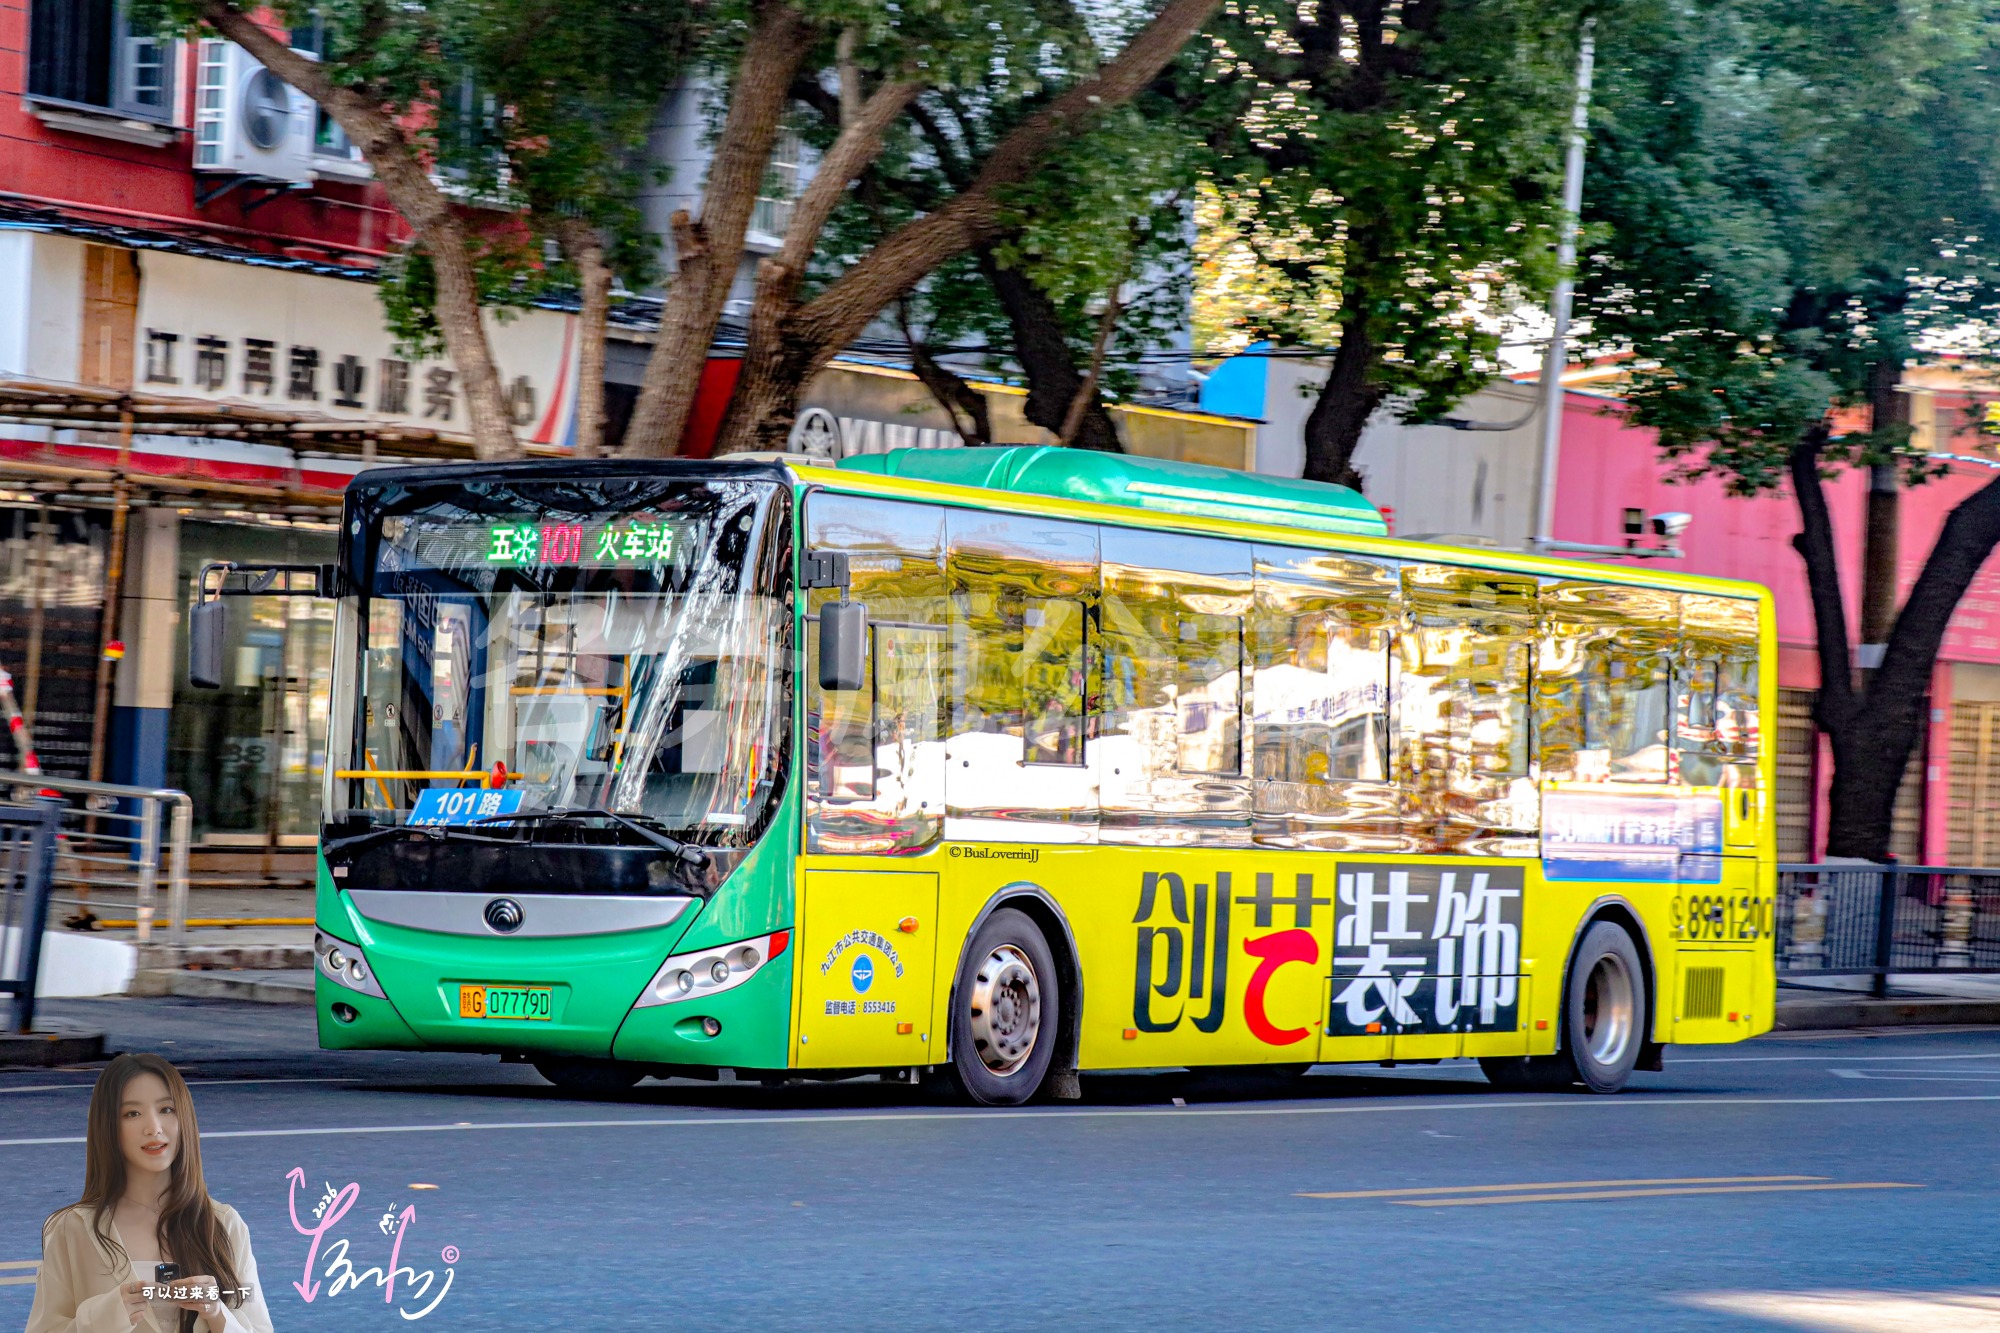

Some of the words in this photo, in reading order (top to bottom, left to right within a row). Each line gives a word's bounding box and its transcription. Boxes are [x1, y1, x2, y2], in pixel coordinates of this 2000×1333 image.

[145, 327, 537, 427] 江市再就业服务心
[540, 523, 583, 564] 101
[594, 523, 674, 561] 火车站
[436, 791, 503, 817] 101路
[820, 929, 904, 979] 九江市公共交通集团公司
